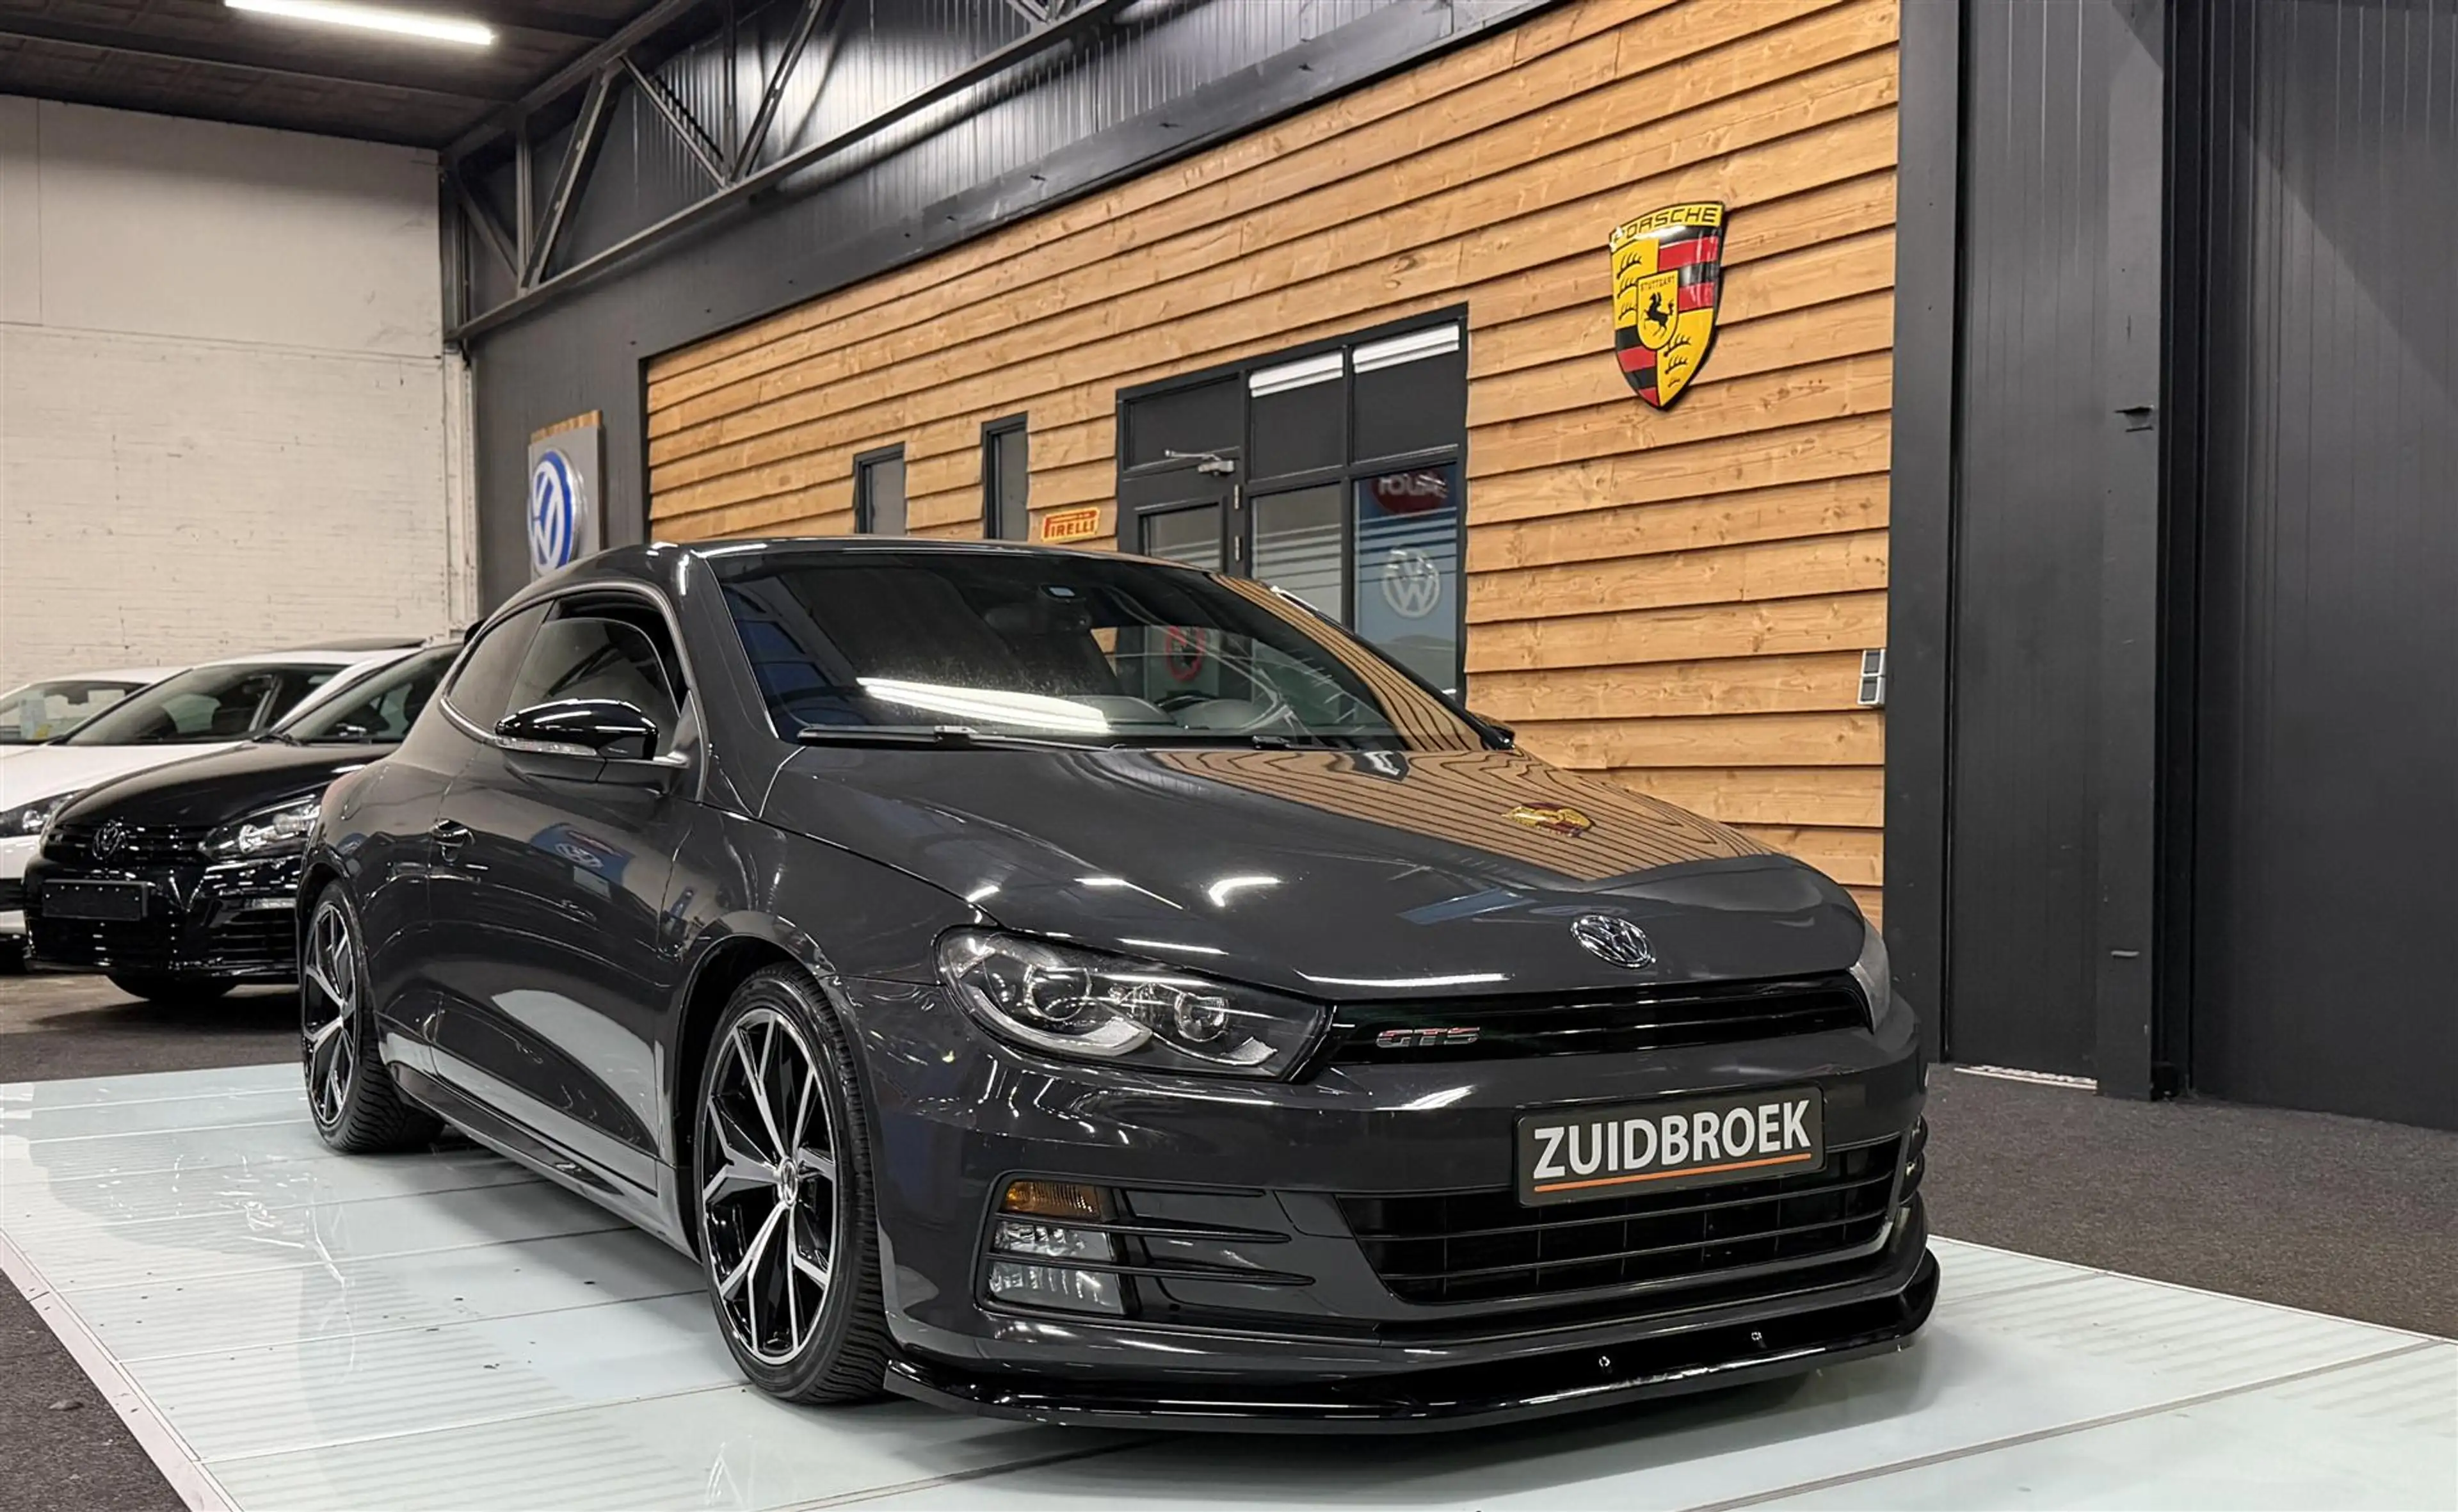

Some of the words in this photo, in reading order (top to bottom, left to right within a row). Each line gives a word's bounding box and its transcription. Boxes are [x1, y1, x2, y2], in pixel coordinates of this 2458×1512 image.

[1044, 511, 1097, 538] PIRELLI
[1376, 1027, 1480, 1049] GTS
[1533, 1099, 1811, 1179] ZUIDBROEK
